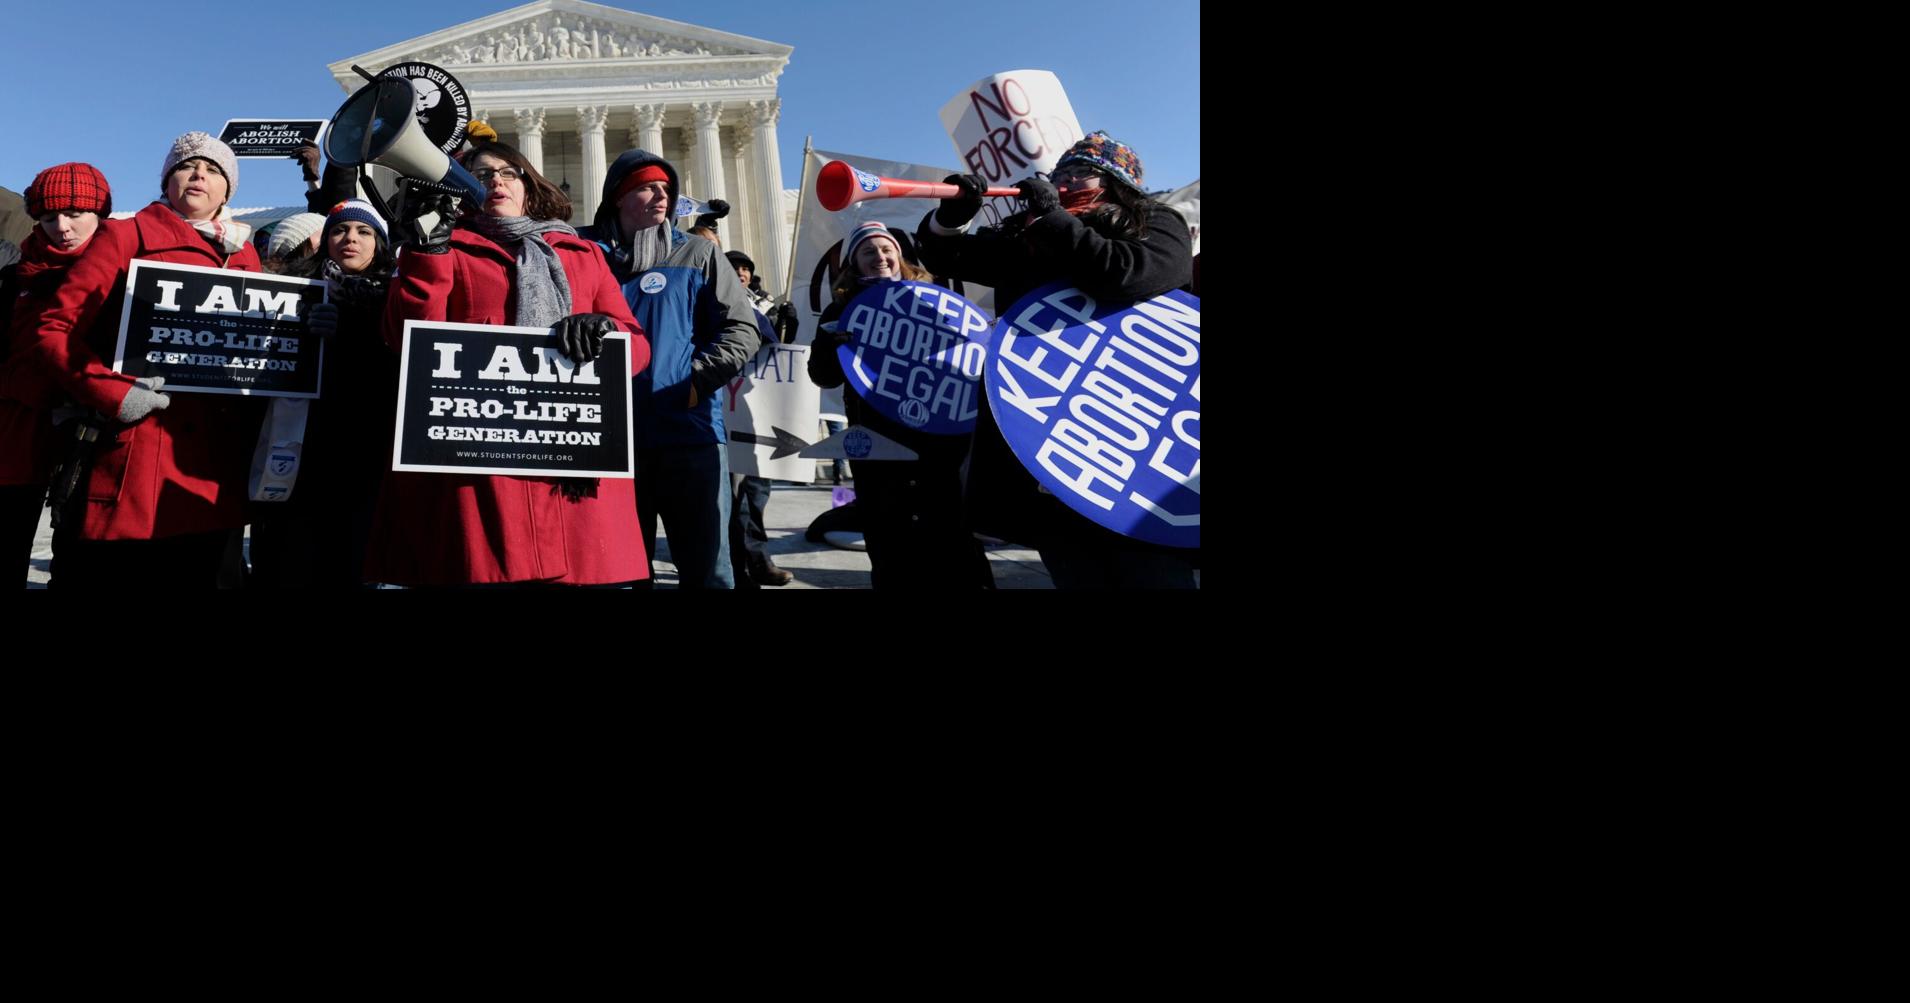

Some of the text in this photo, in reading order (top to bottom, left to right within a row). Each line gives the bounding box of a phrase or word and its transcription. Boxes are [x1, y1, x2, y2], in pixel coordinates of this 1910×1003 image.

[409, 65, 426, 76] HAS
[426, 68, 449, 85] BEEN
[444, 81, 466, 106] KILLED
[456, 107, 468, 117] BY
[970, 78, 1031, 133] NO
[228, 137, 304, 145] ABORTION
[238, 130, 301, 138] ABOLISH
[153, 279, 303, 322] I AM
[882, 285, 988, 337] KEEP
[148, 326, 300, 354] PRO-LIFE
[219, 318, 238, 328] the
[146, 351, 297, 371] GENERATION
[846, 304, 987, 382] ABORTIO
[996, 287, 1108, 425] KEEP
[431, 341, 601, 385] I AM
[736, 346, 805, 383] HAT
[506, 384, 527, 395] the
[852, 346, 979, 422] LEGAL
[428, 397, 602, 424] PRO-LIFE
[1035, 295, 1201, 511] ABORTION
[427, 425, 602, 446] GENERATION
[456, 451, 573, 462] WWW.STUDENTSFORLIFE.ORG
